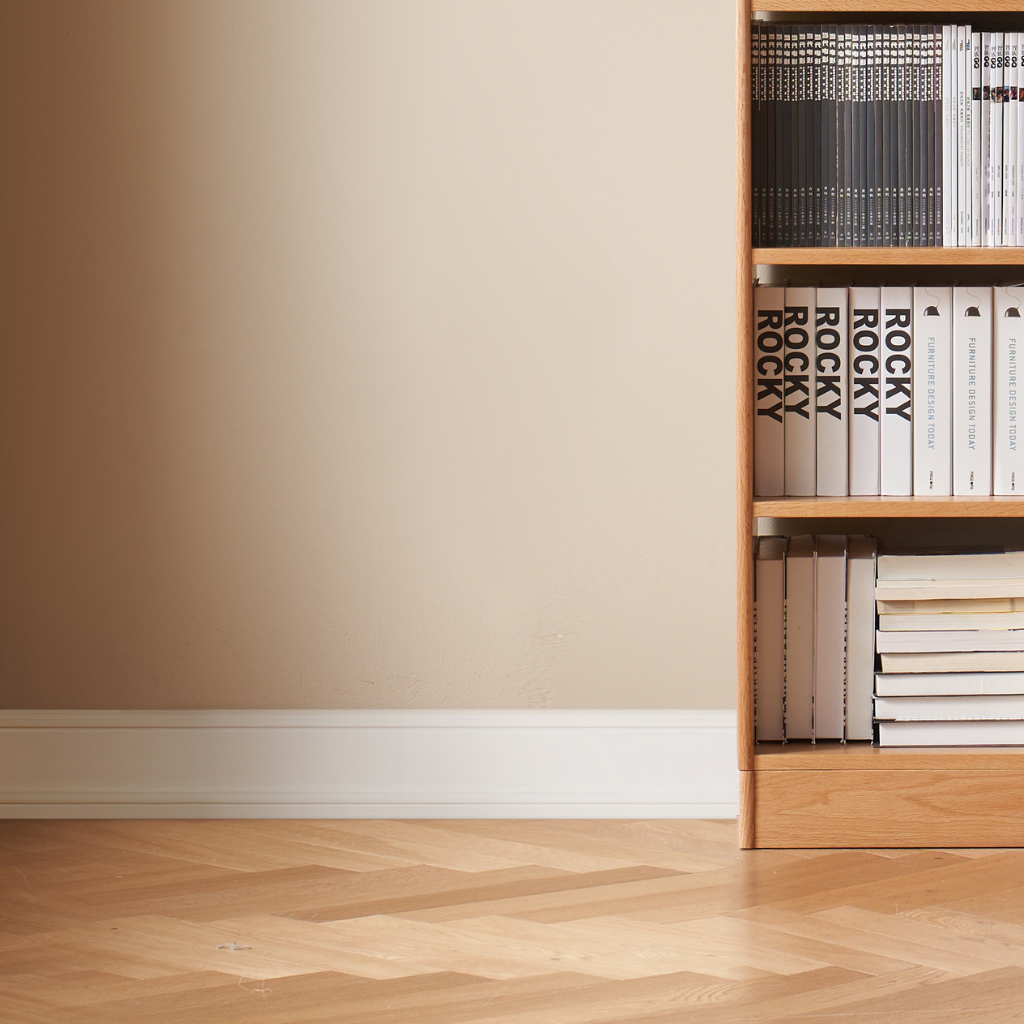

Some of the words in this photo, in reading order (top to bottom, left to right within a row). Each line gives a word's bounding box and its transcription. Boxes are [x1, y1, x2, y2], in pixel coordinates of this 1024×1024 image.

[974, 58, 979, 69] GQ
[984, 56, 989, 67] GQ
[991, 58, 996, 69] GQ
[997, 57, 1002, 68] GQ
[1005, 56, 1010, 67] GQ
[1012, 56, 1017, 67] GQ
[758, 310, 782, 424] ROCKY
[785, 306, 809, 420] ROCKY
[816, 306, 841, 420] ROCKY
[854, 308, 879, 422] ROCKY
[886, 308, 911, 422] ROCKY
[968, 337, 976, 386] FURNITURE
[968, 388, 976, 420] DESIGN
[968, 422, 976, 450] TODAY
